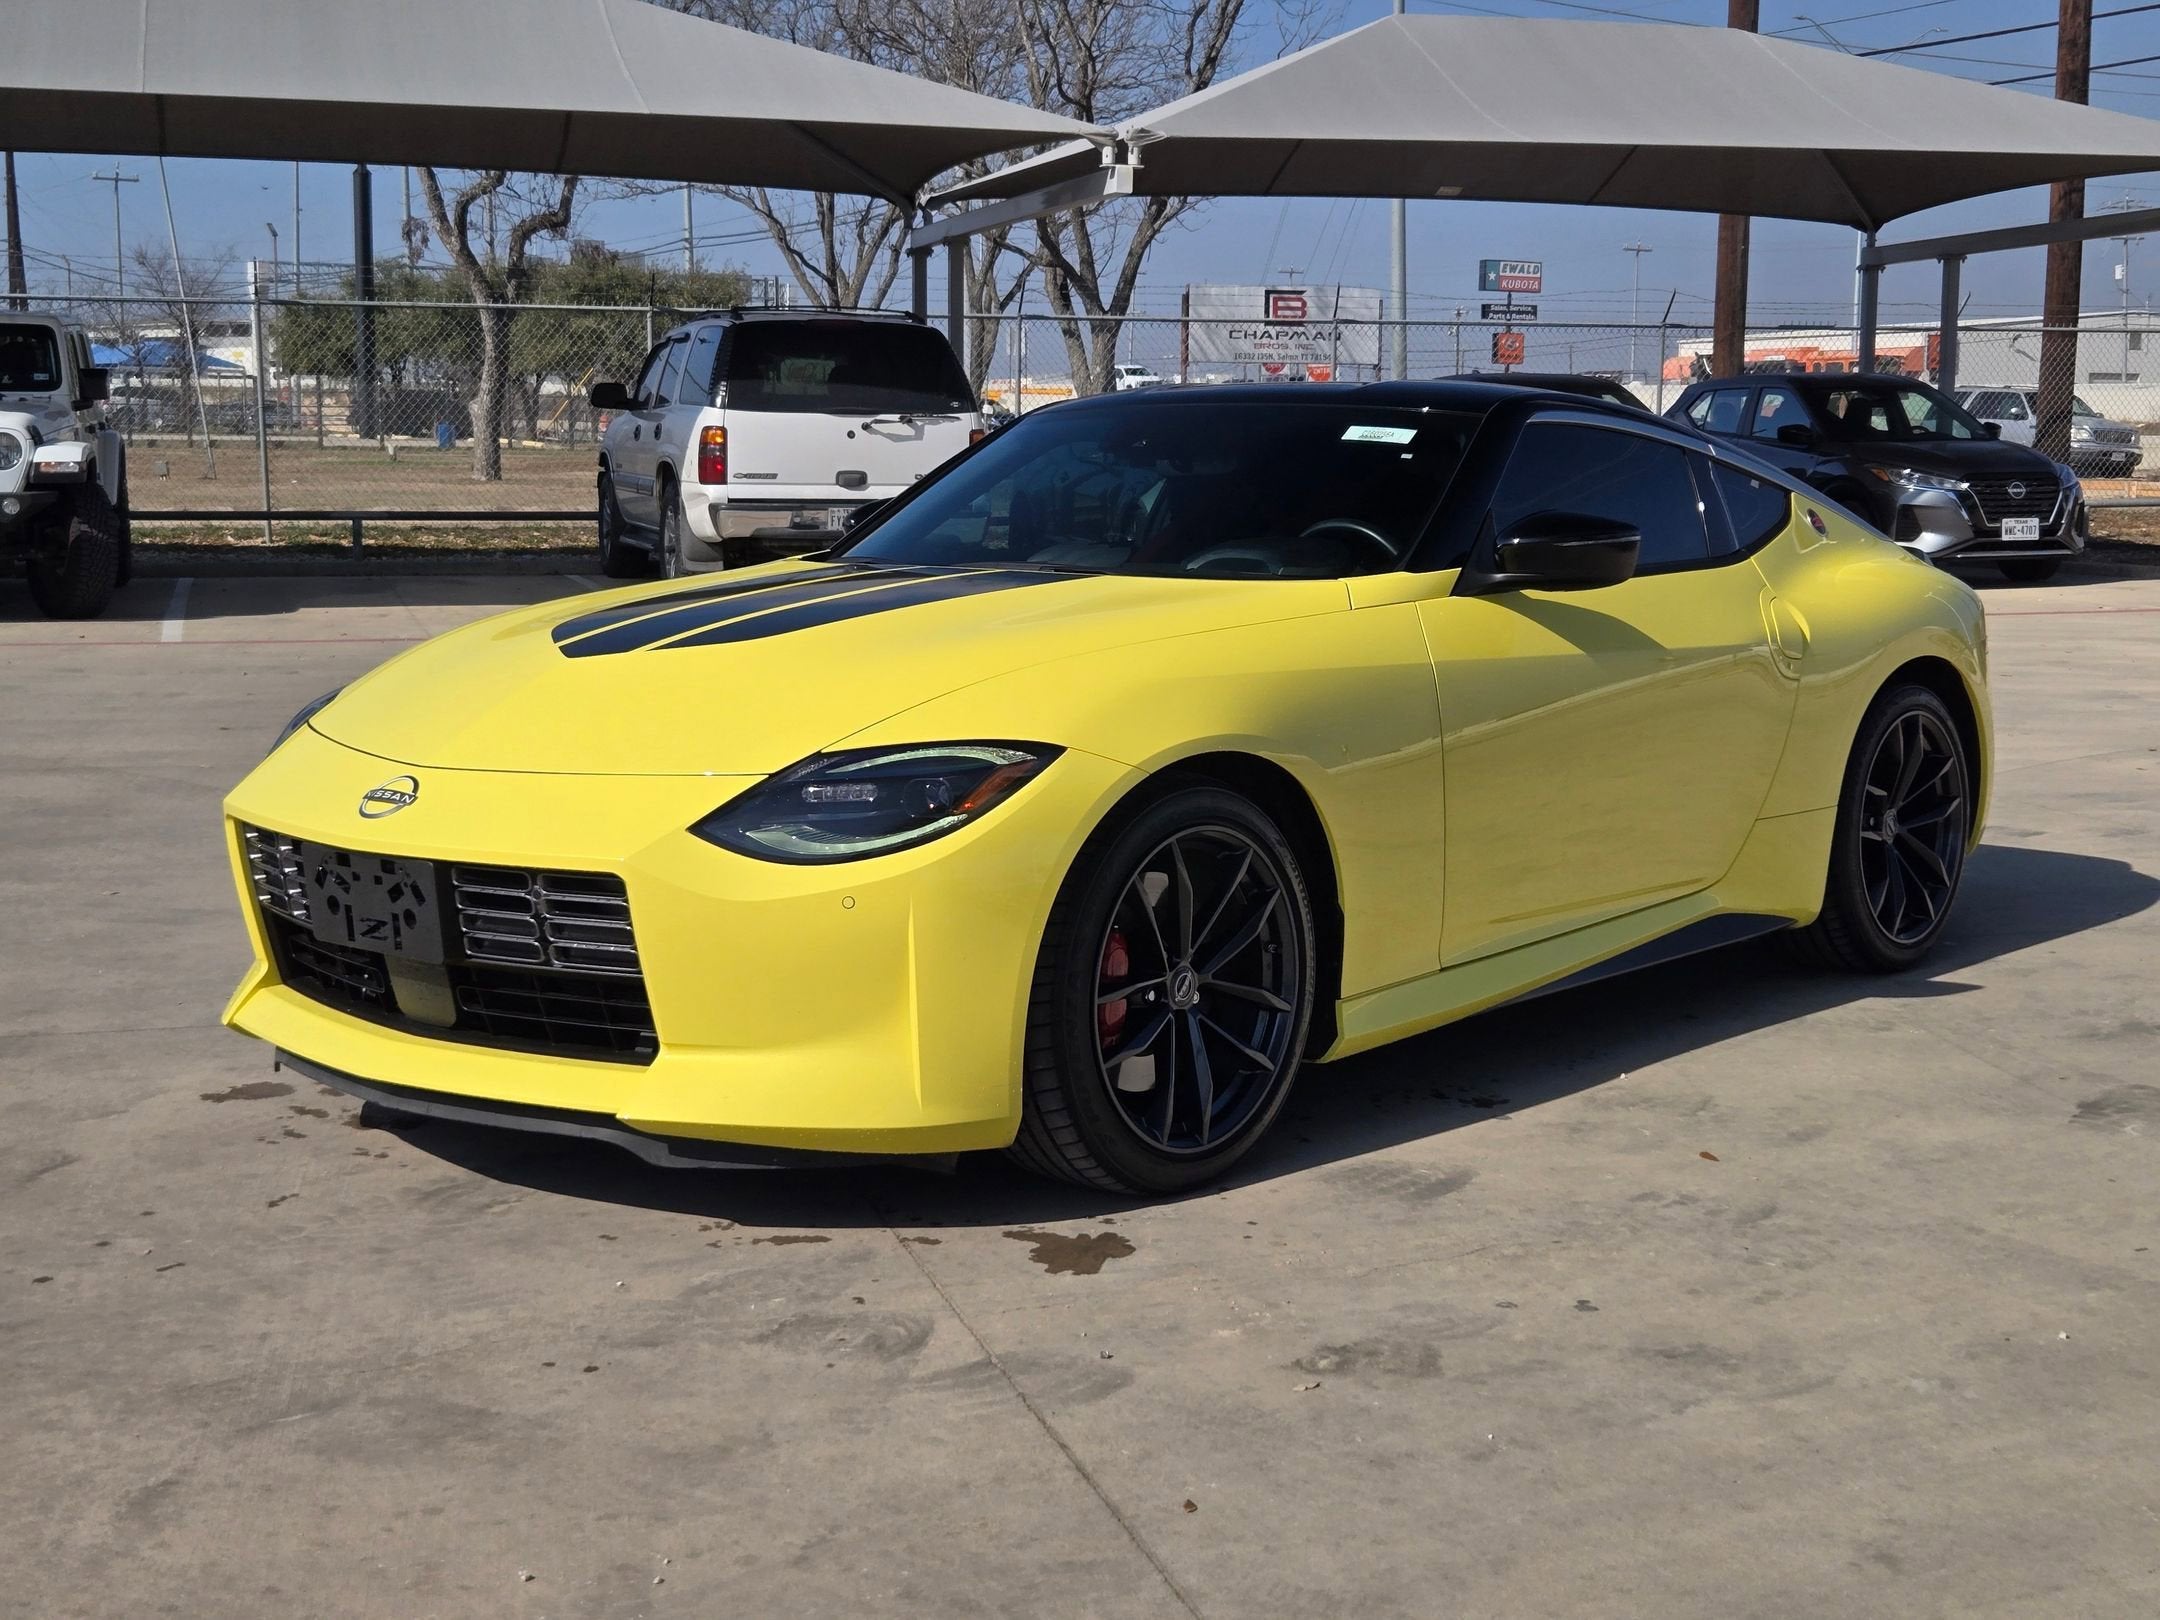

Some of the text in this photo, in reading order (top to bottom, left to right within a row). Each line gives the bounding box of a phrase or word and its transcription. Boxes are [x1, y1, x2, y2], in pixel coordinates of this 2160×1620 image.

[1501, 263, 1540, 275] EWALD
[1501, 279, 1539, 290] KUBOTA
[1229, 329, 1341, 341] CHAPMAN
[366, 789, 415, 804] NISSAN
